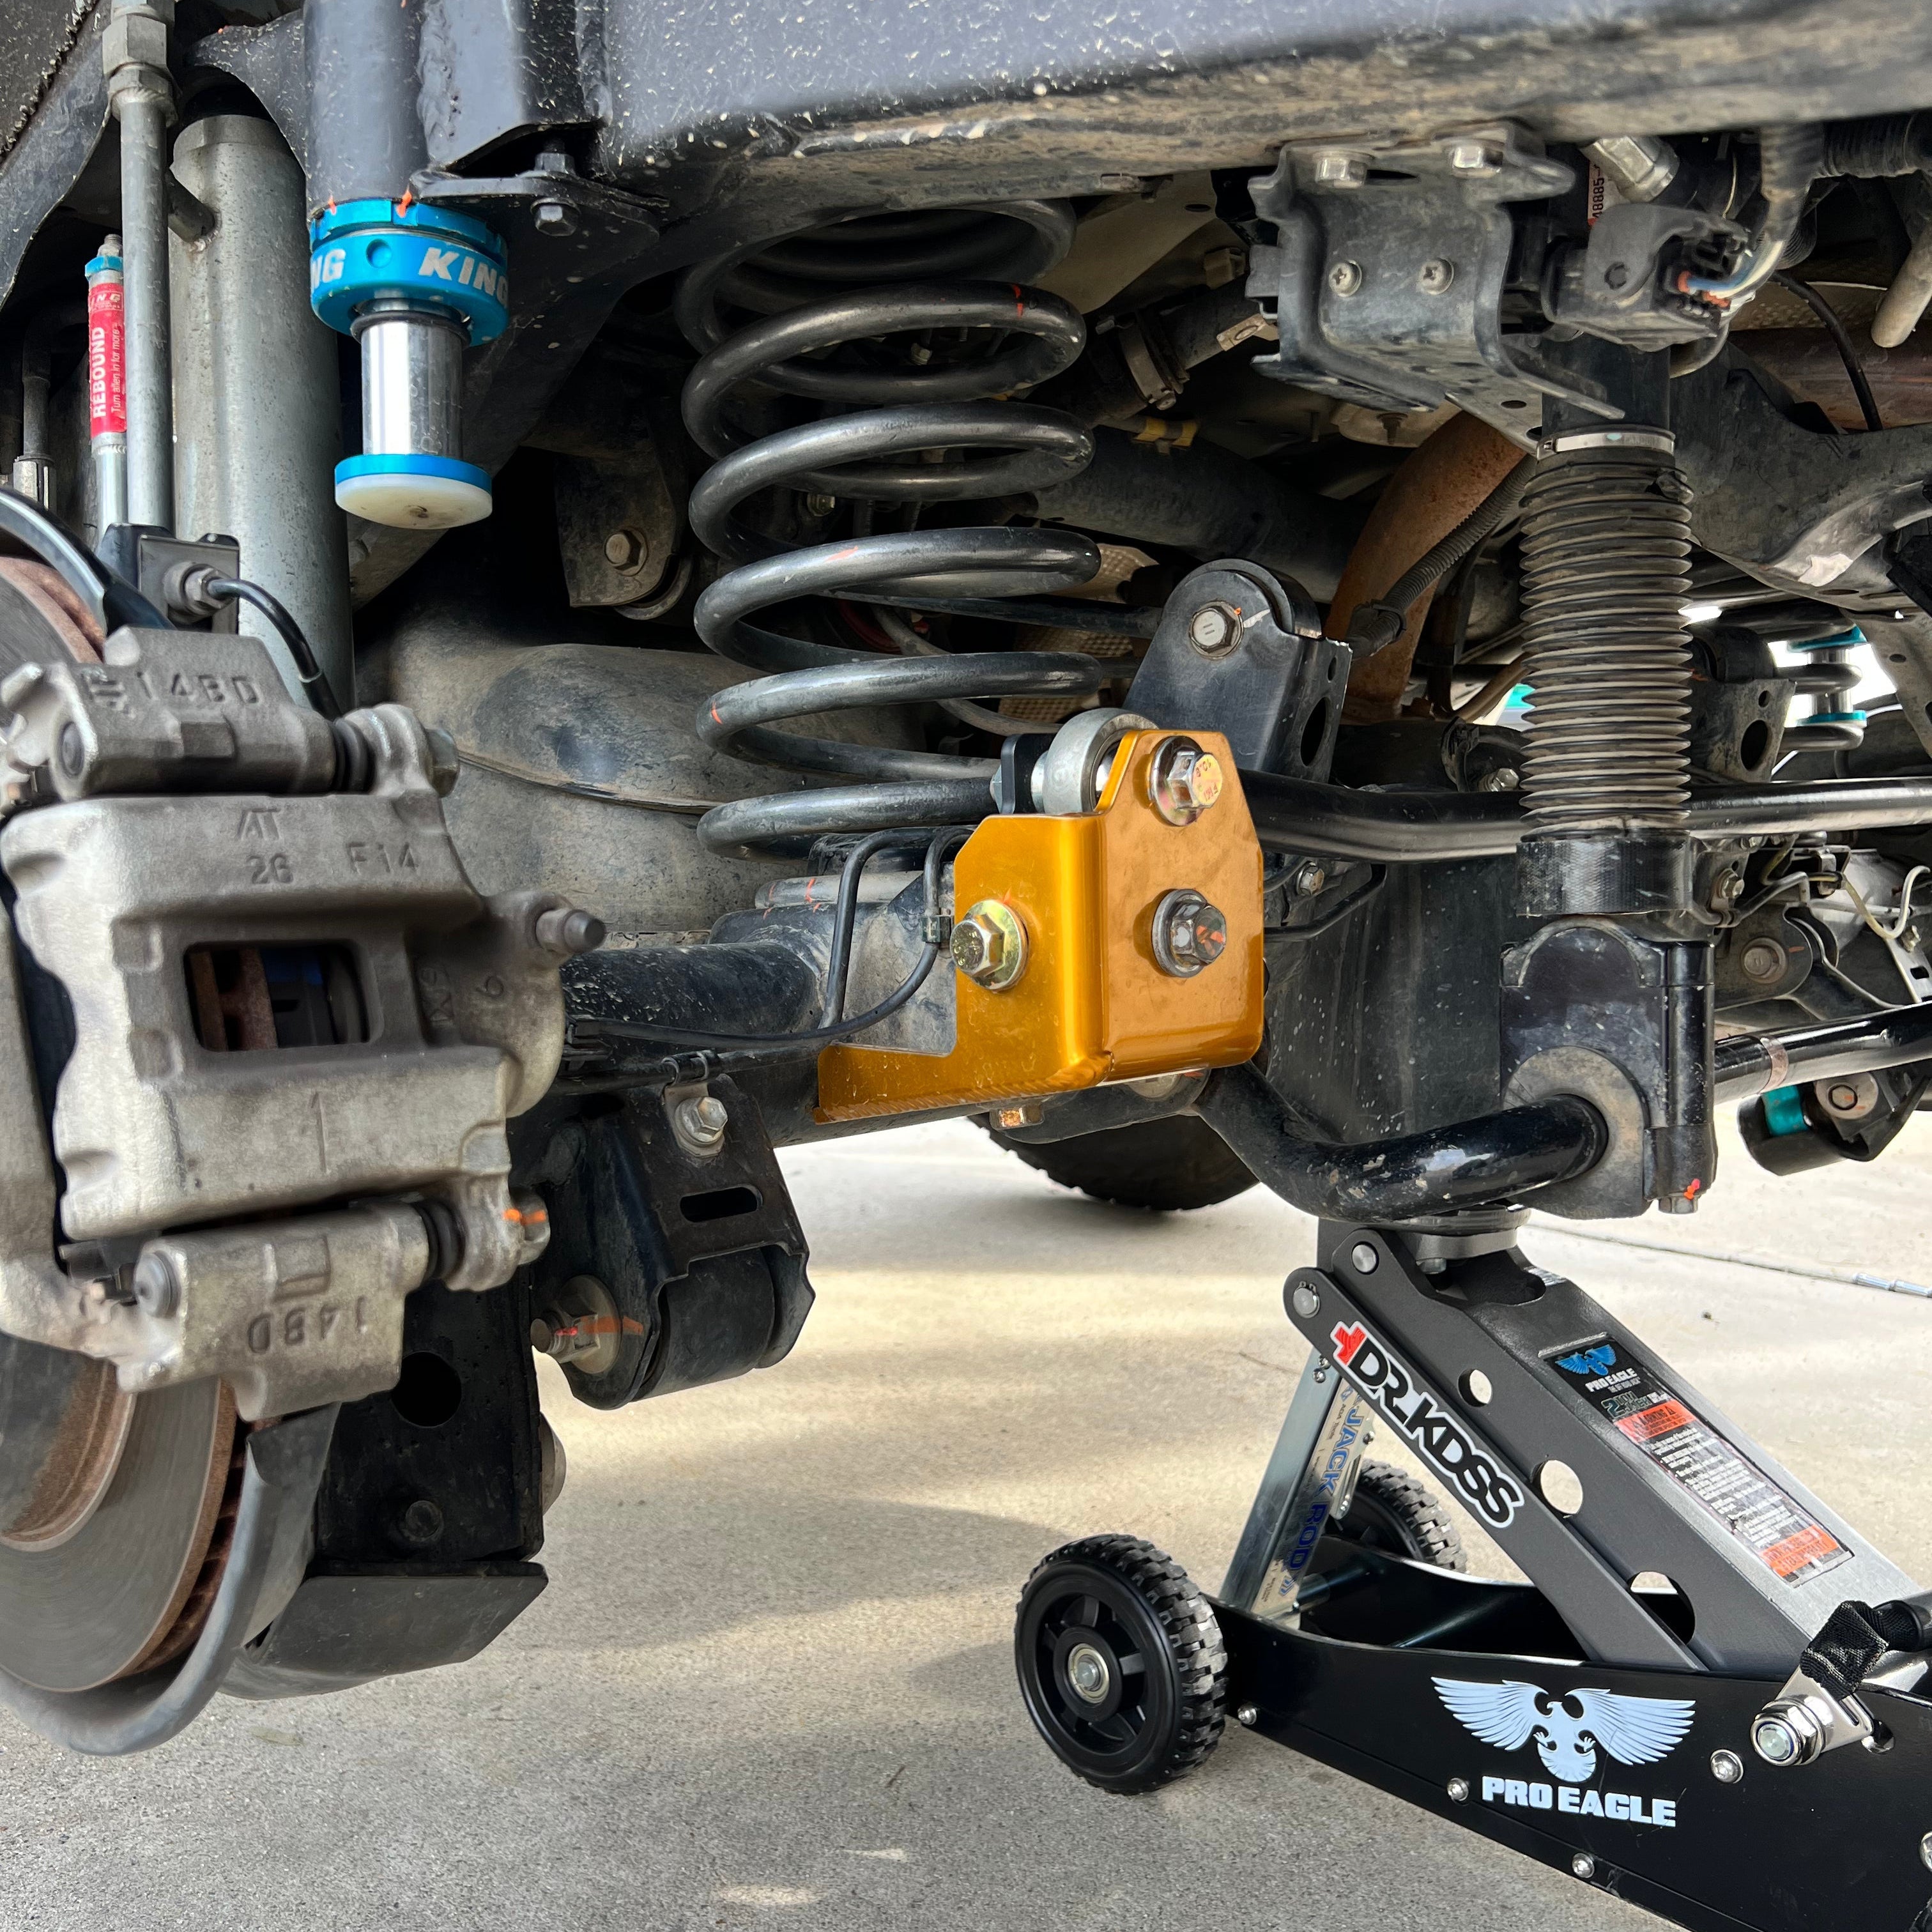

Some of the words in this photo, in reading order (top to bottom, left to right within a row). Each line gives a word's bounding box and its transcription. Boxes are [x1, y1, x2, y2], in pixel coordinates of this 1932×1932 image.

[1592, 164, 1604, 218] 48885-
[310, 248, 346, 292] NG
[418, 247, 509, 309] KING
[91, 326, 107, 418] REBOUND
[1584, 1377, 1609, 1393] PRO
[1605, 1367, 1638, 1386] EAGLE
[1601, 1397, 1620, 1418] 2
[1315, 1406, 1364, 1497] JACK
[1288, 1503, 1328, 1570] ROD
[1482, 1775, 1552, 1809] PRO
[1558, 1786, 1676, 1828] EAGLE
